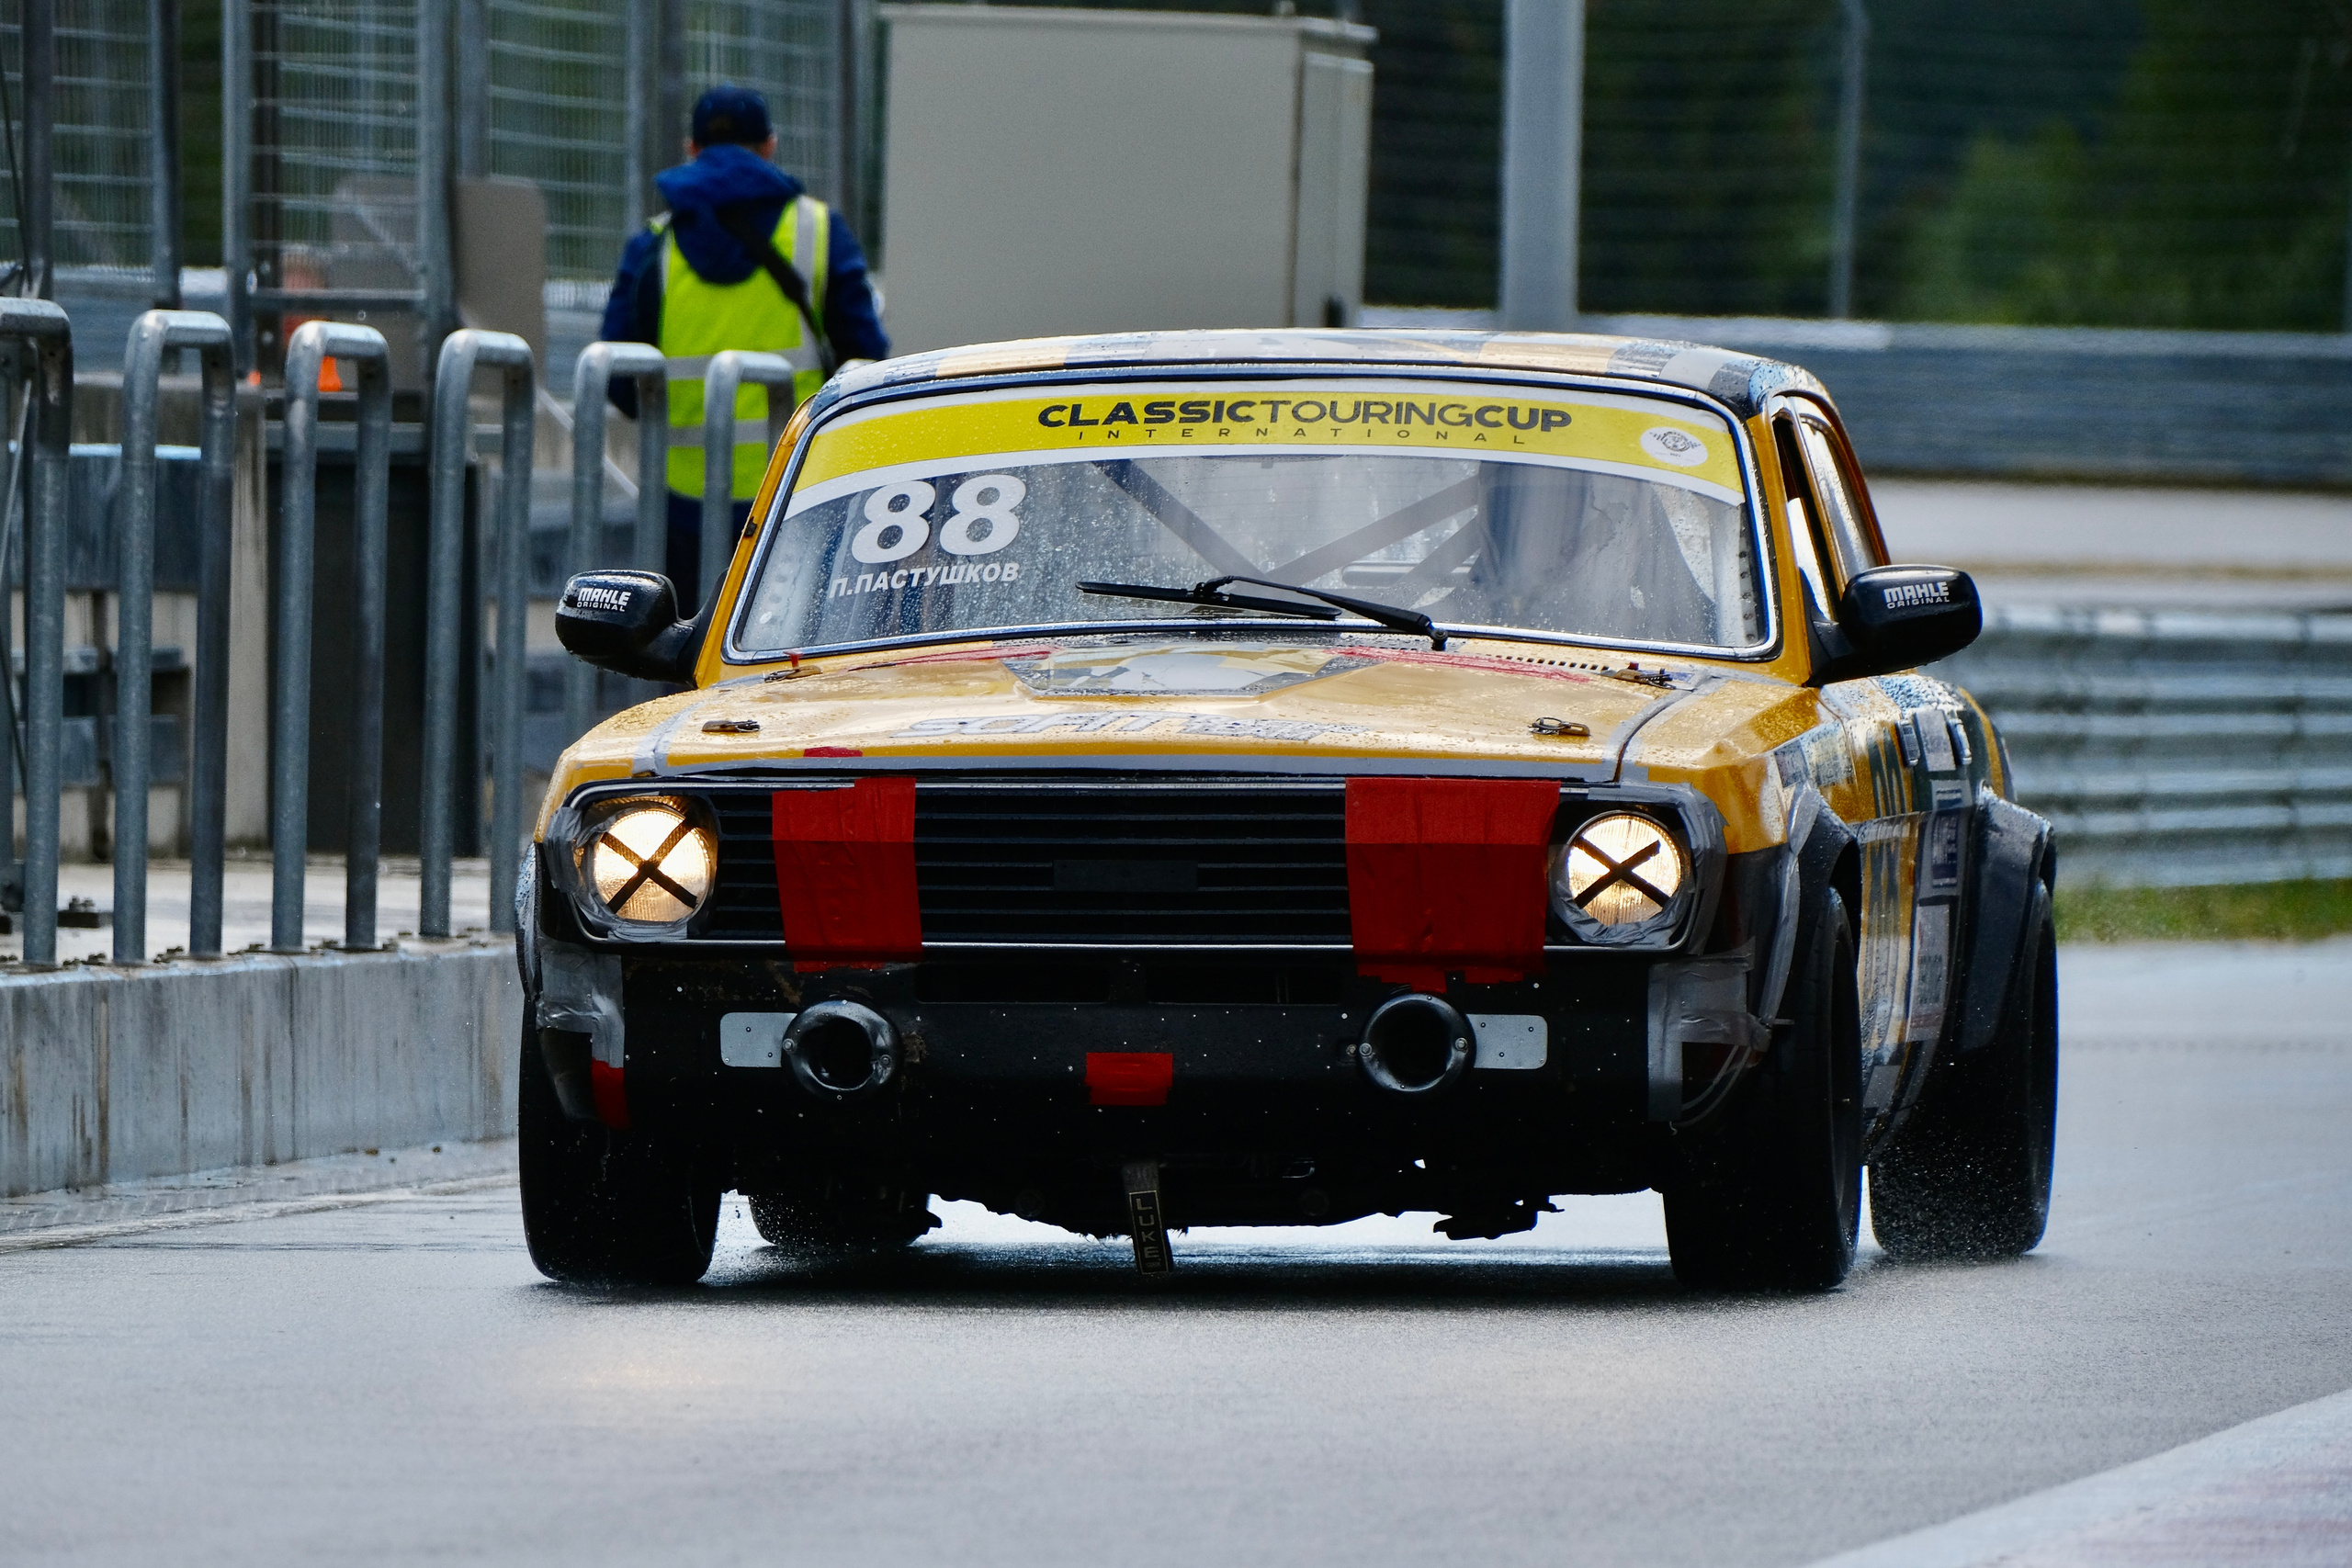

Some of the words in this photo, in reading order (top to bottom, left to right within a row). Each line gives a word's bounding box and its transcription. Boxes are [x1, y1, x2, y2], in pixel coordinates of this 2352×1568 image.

[1079, 427, 1525, 445] INTERNATIONAL
[852, 474, 1026, 563] 88
[577, 588, 632, 606] MAHLE
[1883, 581, 1950, 603] MAHLE
[576, 601, 626, 613] ORIGINAL
[1886, 596, 1951, 609] ORIGINAL
[1136, 1198, 1160, 1258] LUKE
